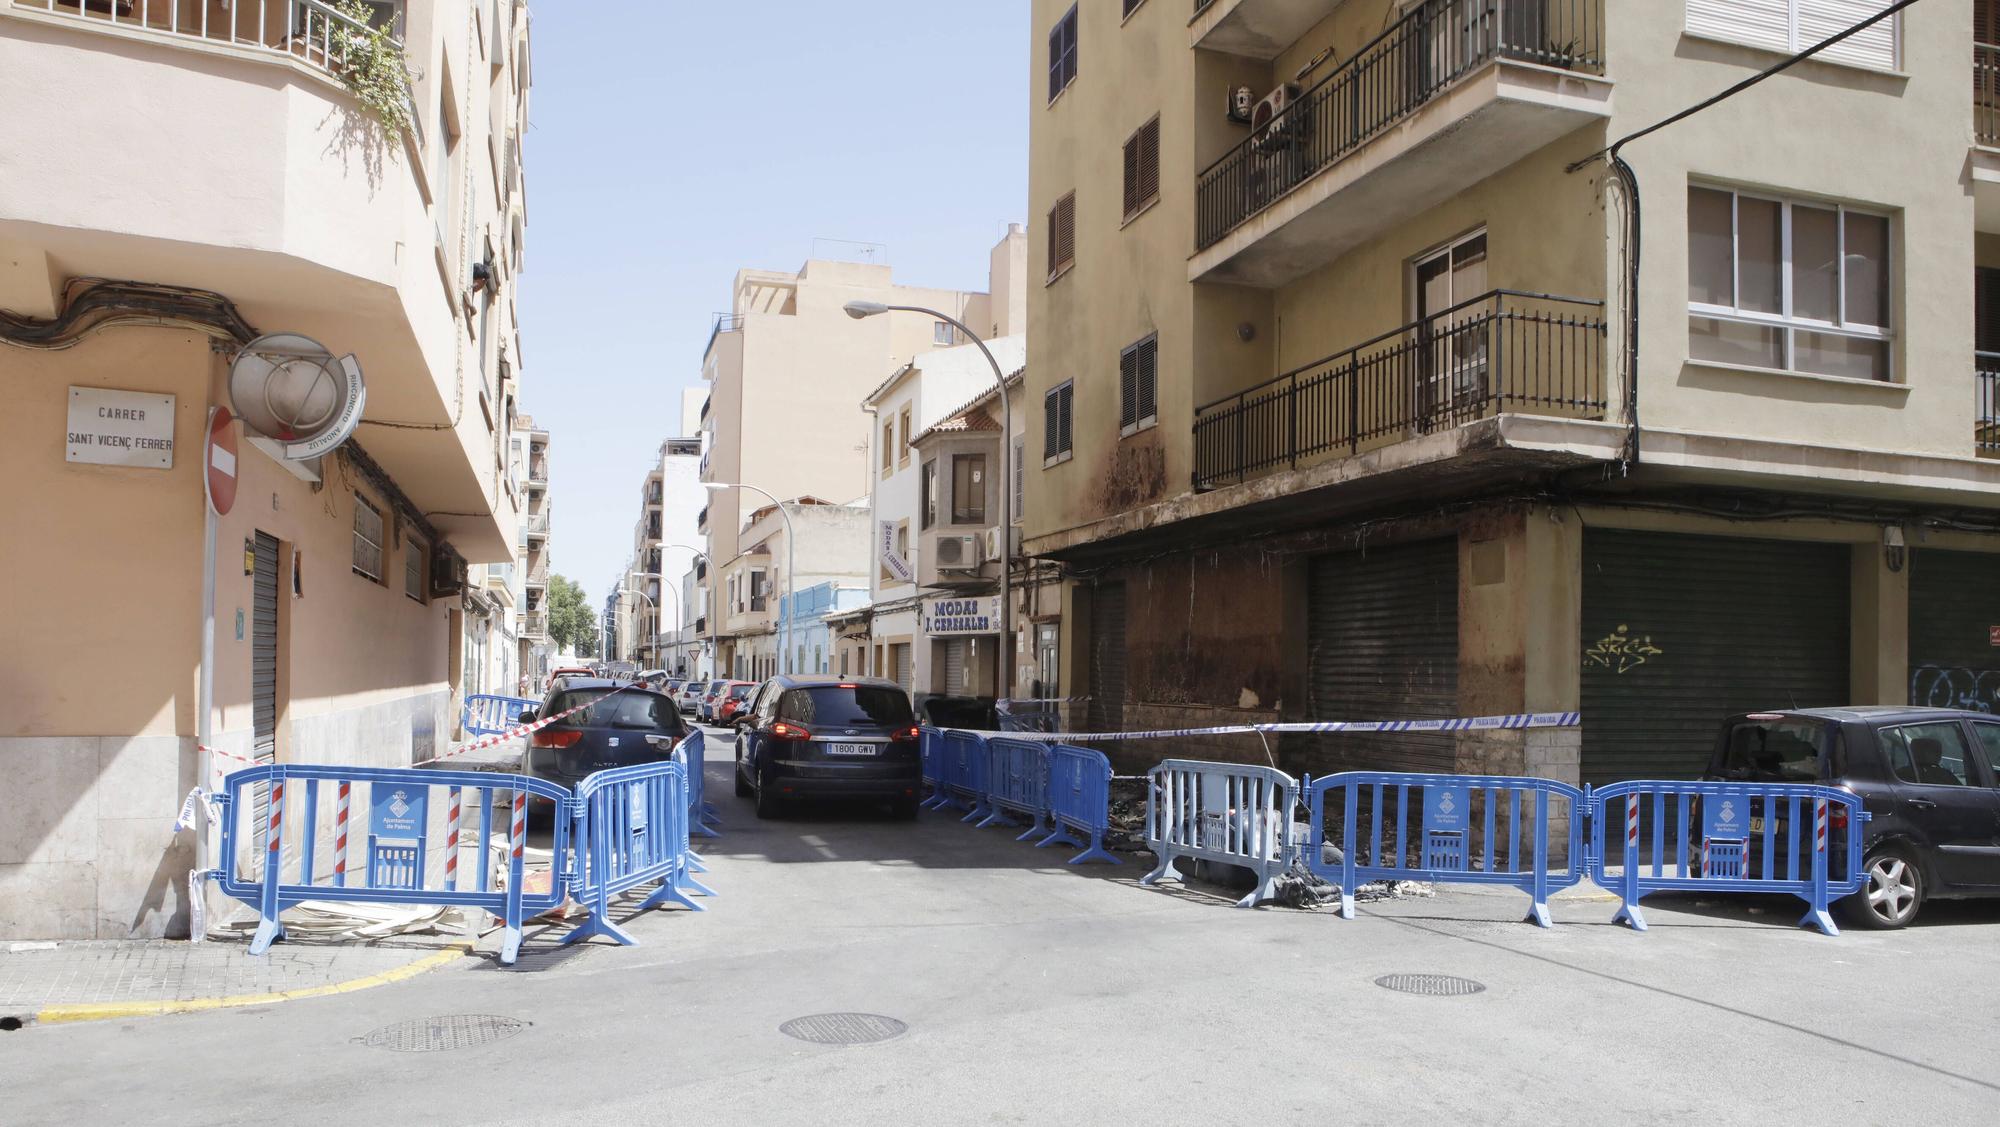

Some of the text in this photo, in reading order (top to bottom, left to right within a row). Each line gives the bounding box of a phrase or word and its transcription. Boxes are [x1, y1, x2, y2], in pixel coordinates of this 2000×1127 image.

[98, 407, 145, 421] CARRER
[308, 374, 358, 450] RINCONCITO ANDALUZ
[68, 432, 172, 451] SANT VICENÇ FERRER
[934, 600, 978, 616] MODAS
[925, 617, 933, 632] J.
[834, 744, 875, 754] 1800 GWV
